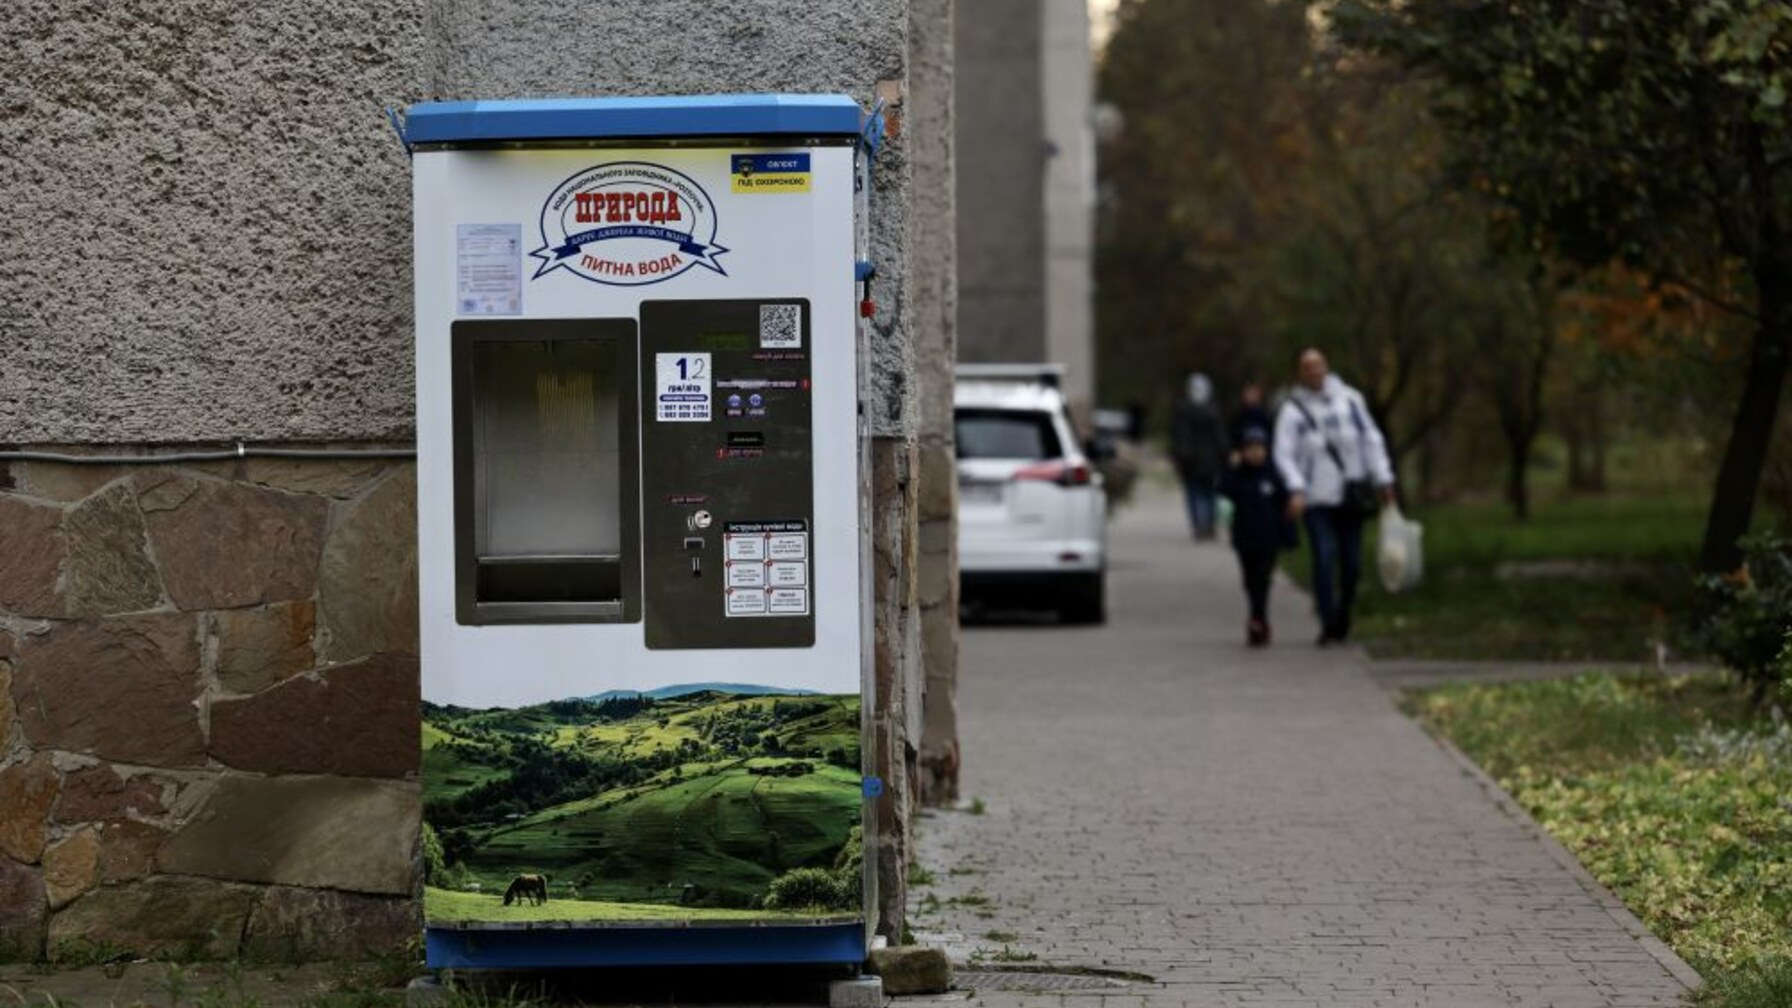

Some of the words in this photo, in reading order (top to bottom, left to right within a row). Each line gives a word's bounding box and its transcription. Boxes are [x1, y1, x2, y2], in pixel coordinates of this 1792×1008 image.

[737, 178, 754, 188] ПІД
[575, 191, 681, 224] ПРИРОДА
[580, 254, 635, 276] ПИТНА
[639, 253, 682, 276] ВОДА
